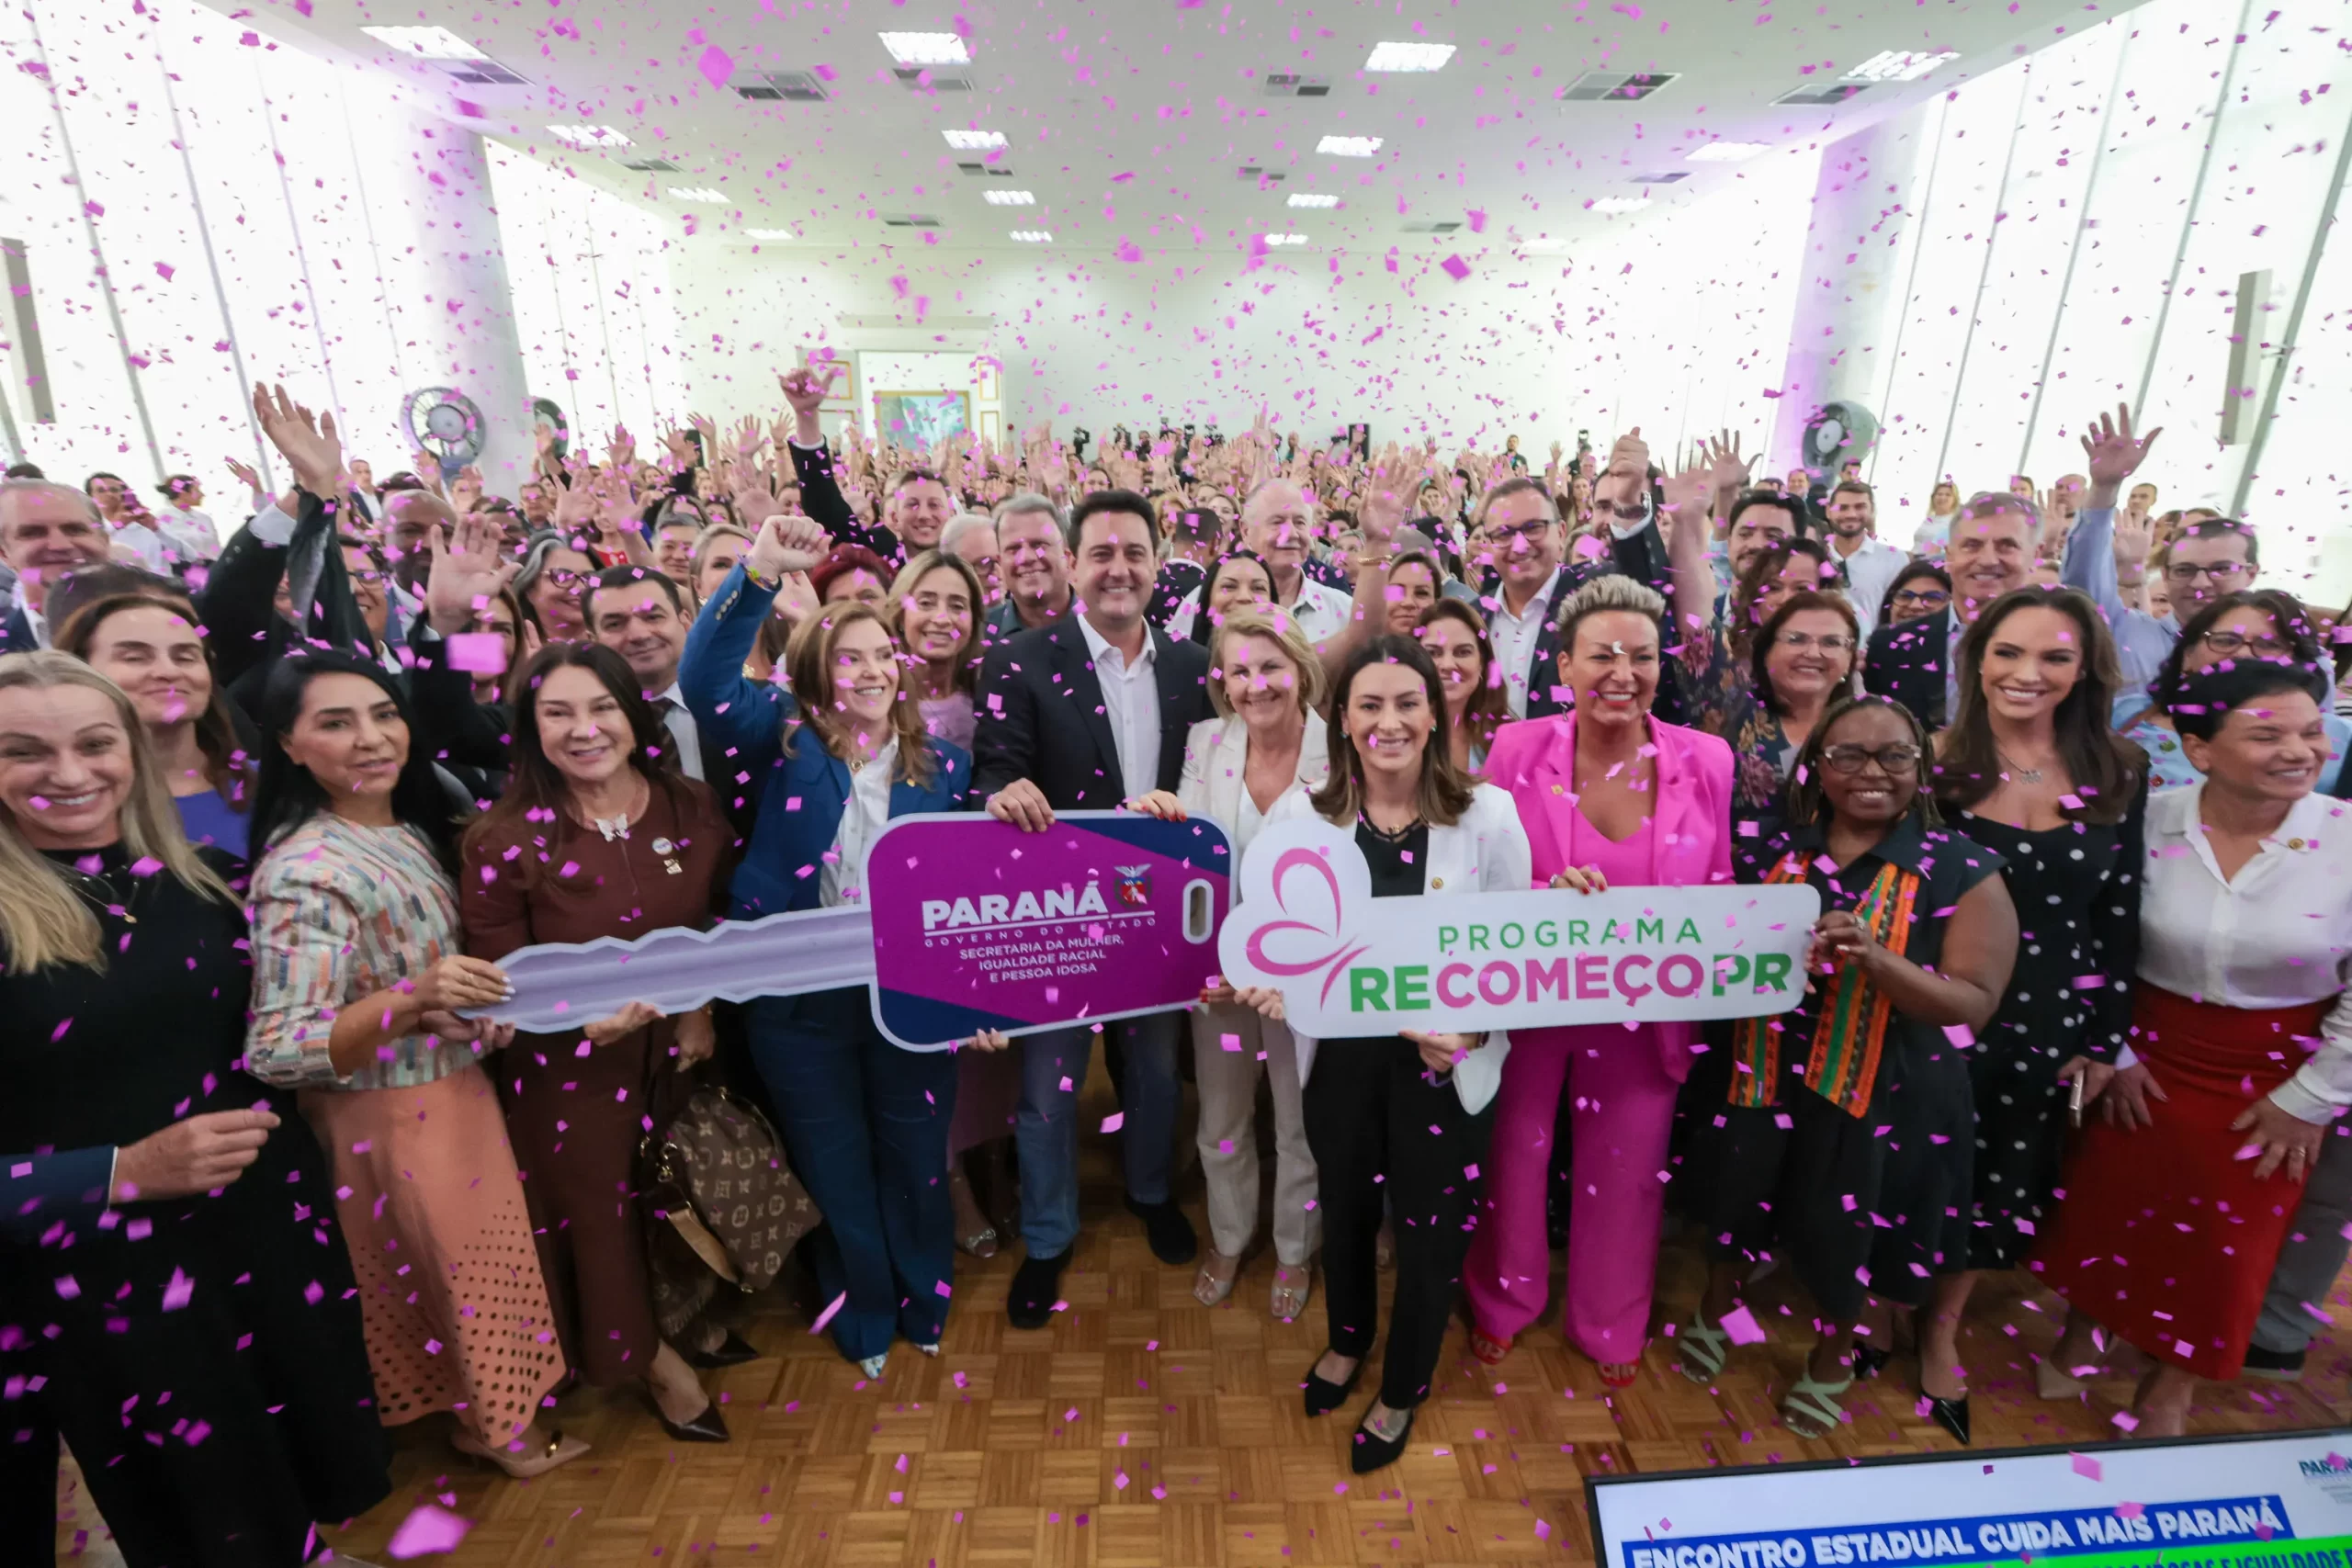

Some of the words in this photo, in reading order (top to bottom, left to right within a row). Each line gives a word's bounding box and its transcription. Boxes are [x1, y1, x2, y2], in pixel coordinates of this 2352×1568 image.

[922, 880, 1108, 930] PARANÁ
[924, 929, 1023, 948] GOVERNO
[1040, 924, 1064, 936] DO
[1438, 918, 1702, 953] PROGRAMA
[959, 941, 1043, 960] SECRETARIA
[1046, 939, 1065, 951] DA
[979, 953, 1056, 971] IGUALDADE
[1058, 948, 1106, 962] RACIAL
[989, 973, 1000, 983] E
[1001, 968, 1054, 982] PESSOA
[1057, 963, 1097, 976] IDOSA
[1632, 1538, 1806, 1568] ENCONTRO
[1811, 1526, 1975, 1565] ESTADUAL
[1978, 1518, 2075, 1553] CUIDA
[2075, 1512, 2154, 1546] MAIS
[2154, 1497, 2285, 1540] PARANÁ
